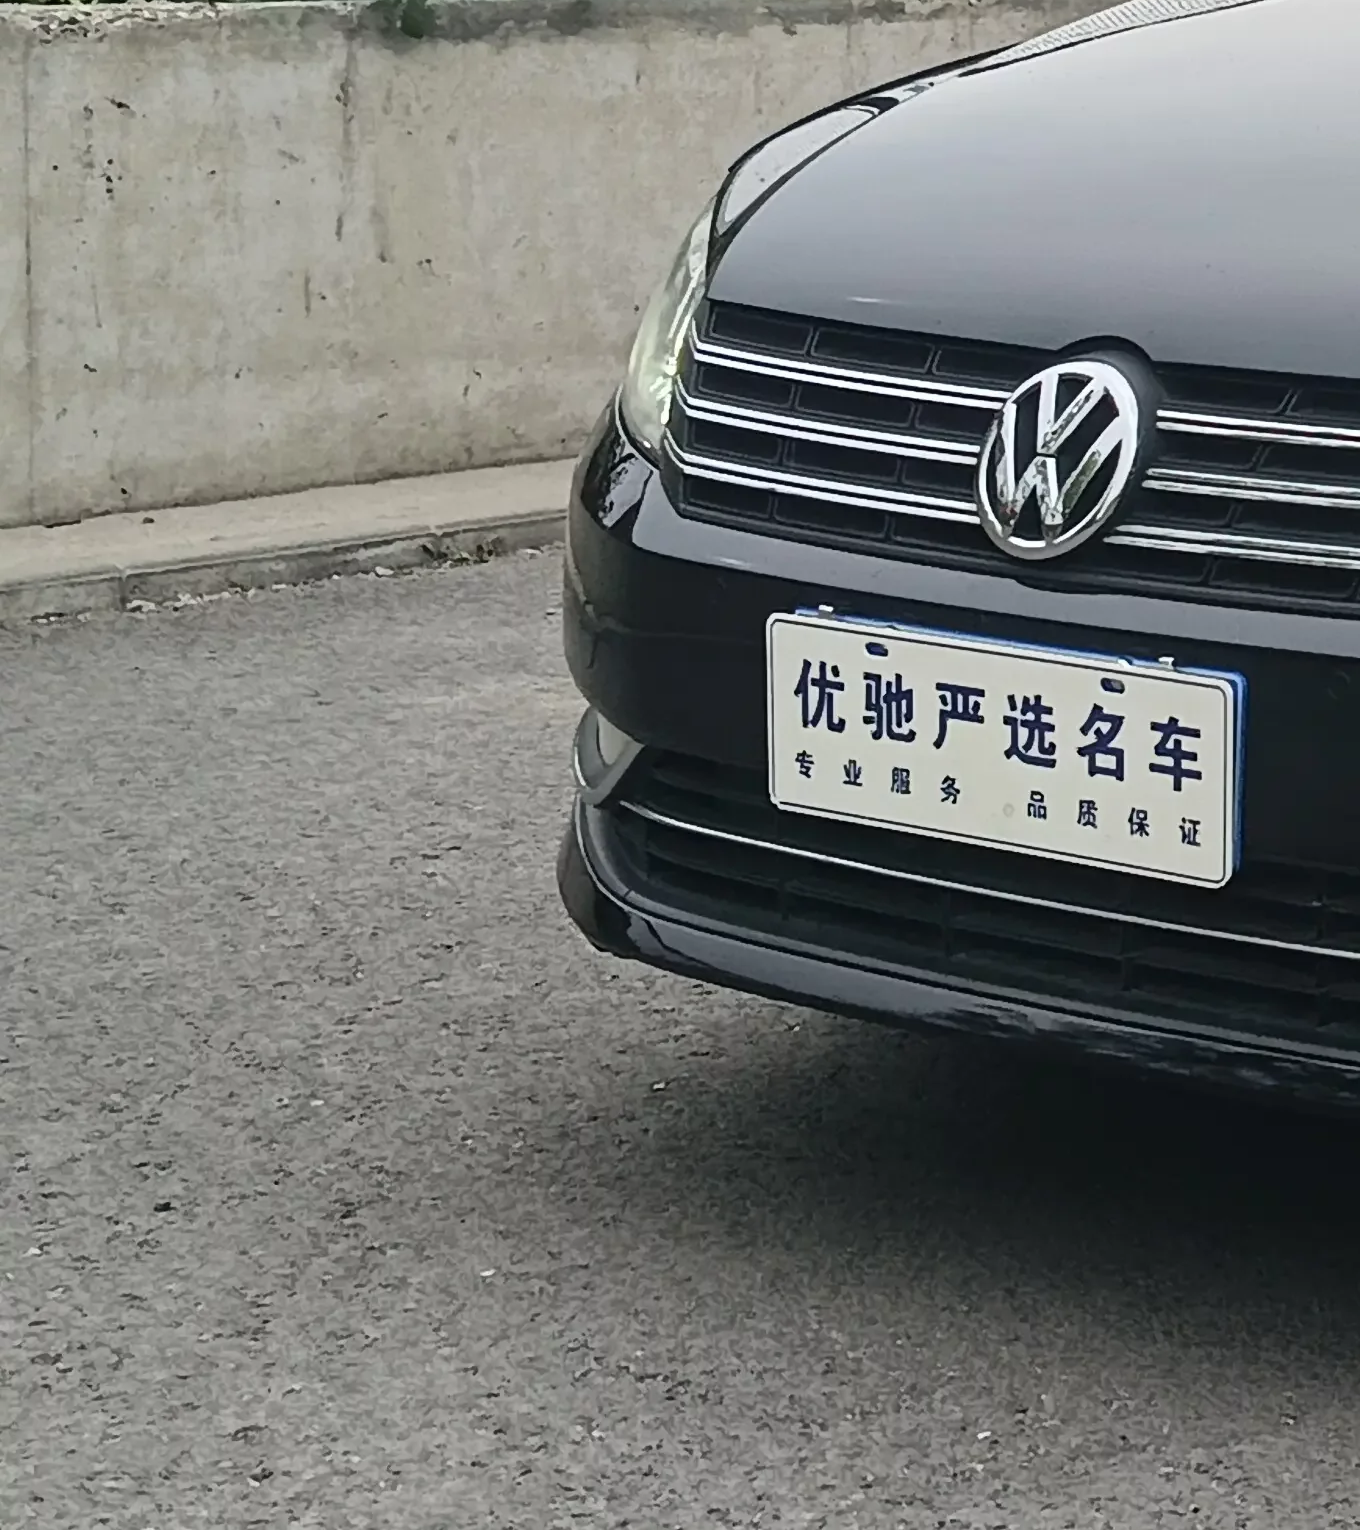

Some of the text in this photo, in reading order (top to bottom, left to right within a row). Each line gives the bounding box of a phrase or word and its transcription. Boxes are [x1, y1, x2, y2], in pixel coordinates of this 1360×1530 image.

[793, 658, 1203, 792] 优驰严选名车
[793, 749, 1202, 848] 专业服务 品质保证
